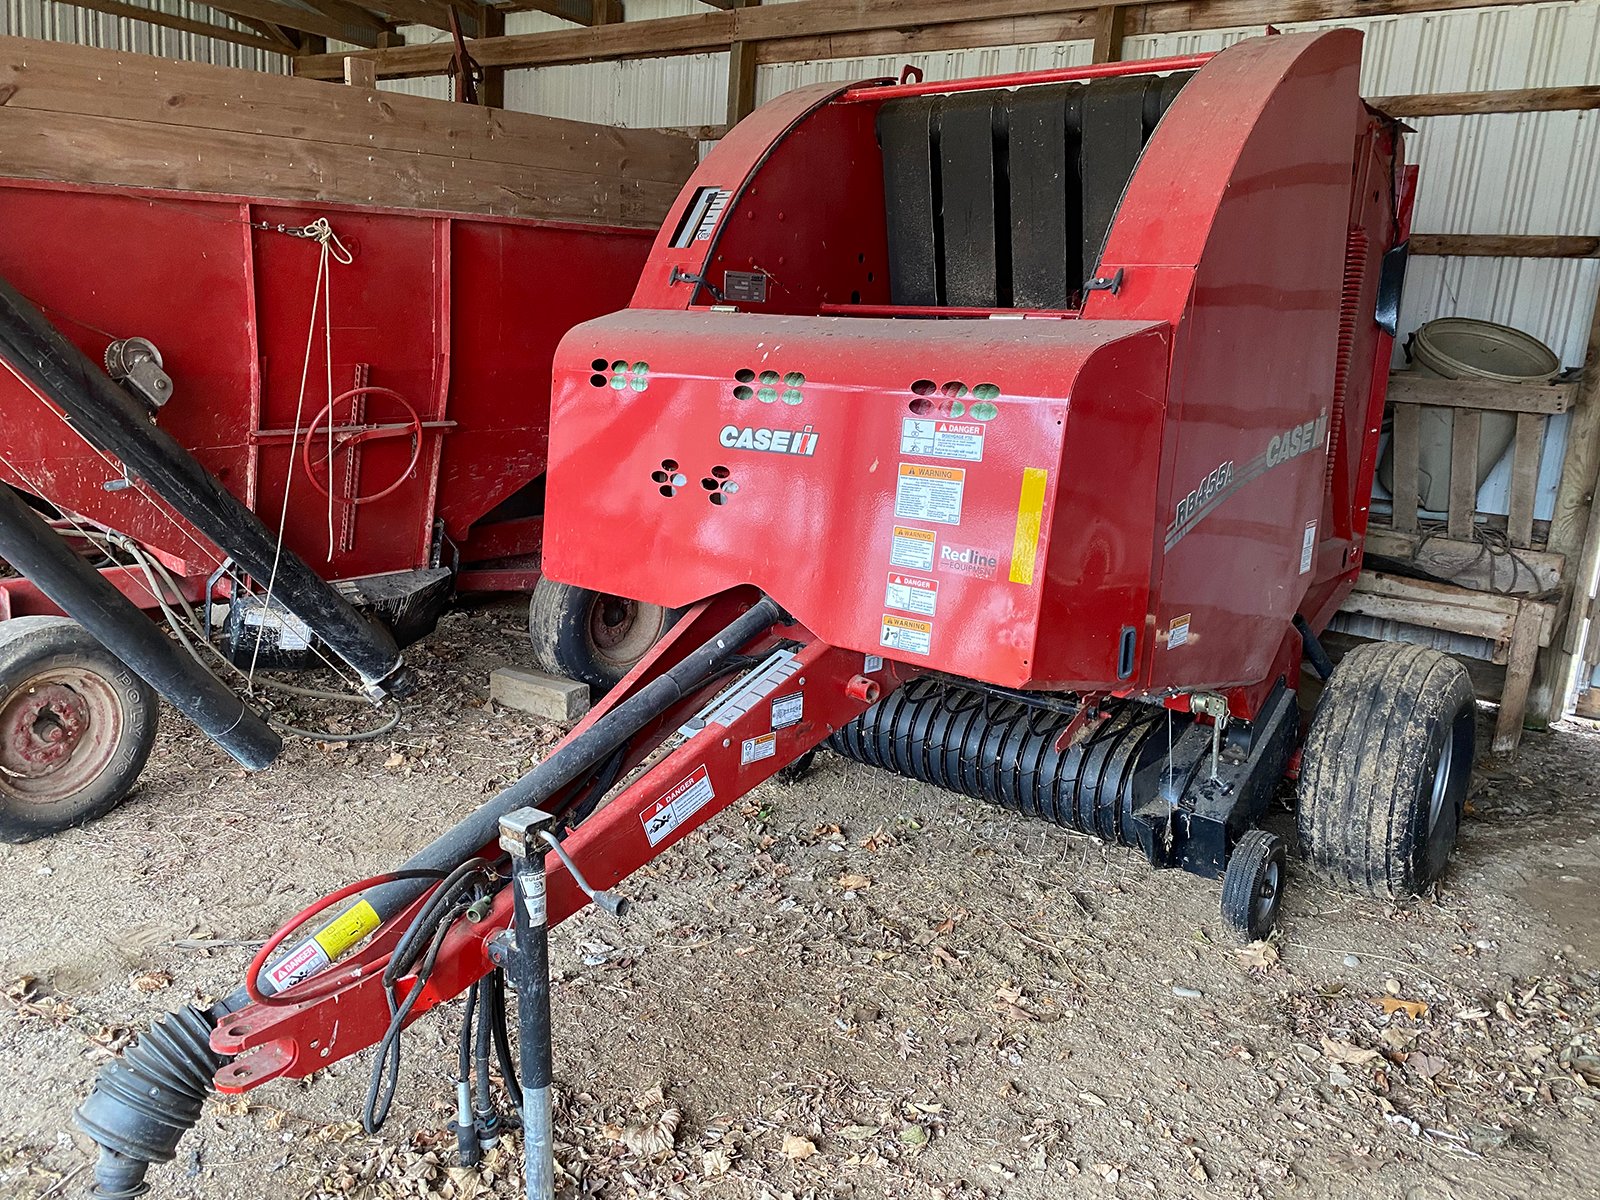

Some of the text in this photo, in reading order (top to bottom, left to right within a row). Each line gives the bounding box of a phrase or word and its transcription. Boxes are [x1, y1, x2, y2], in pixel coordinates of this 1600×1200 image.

[719, 425, 792, 453] CASE
[948, 424, 980, 434] DANGER
[1266, 422, 1314, 467] CASE
[918, 468, 953, 478] WARNING
[1174, 460, 1234, 527] RB455A
[904, 529, 931, 540] WARNING
[941, 545, 997, 568] Redline
[903, 578, 931, 589] DANGER
[894, 619, 926, 631] WARNING
[665, 777, 695, 803] DANGER
[284, 946, 316, 973] DANGER
